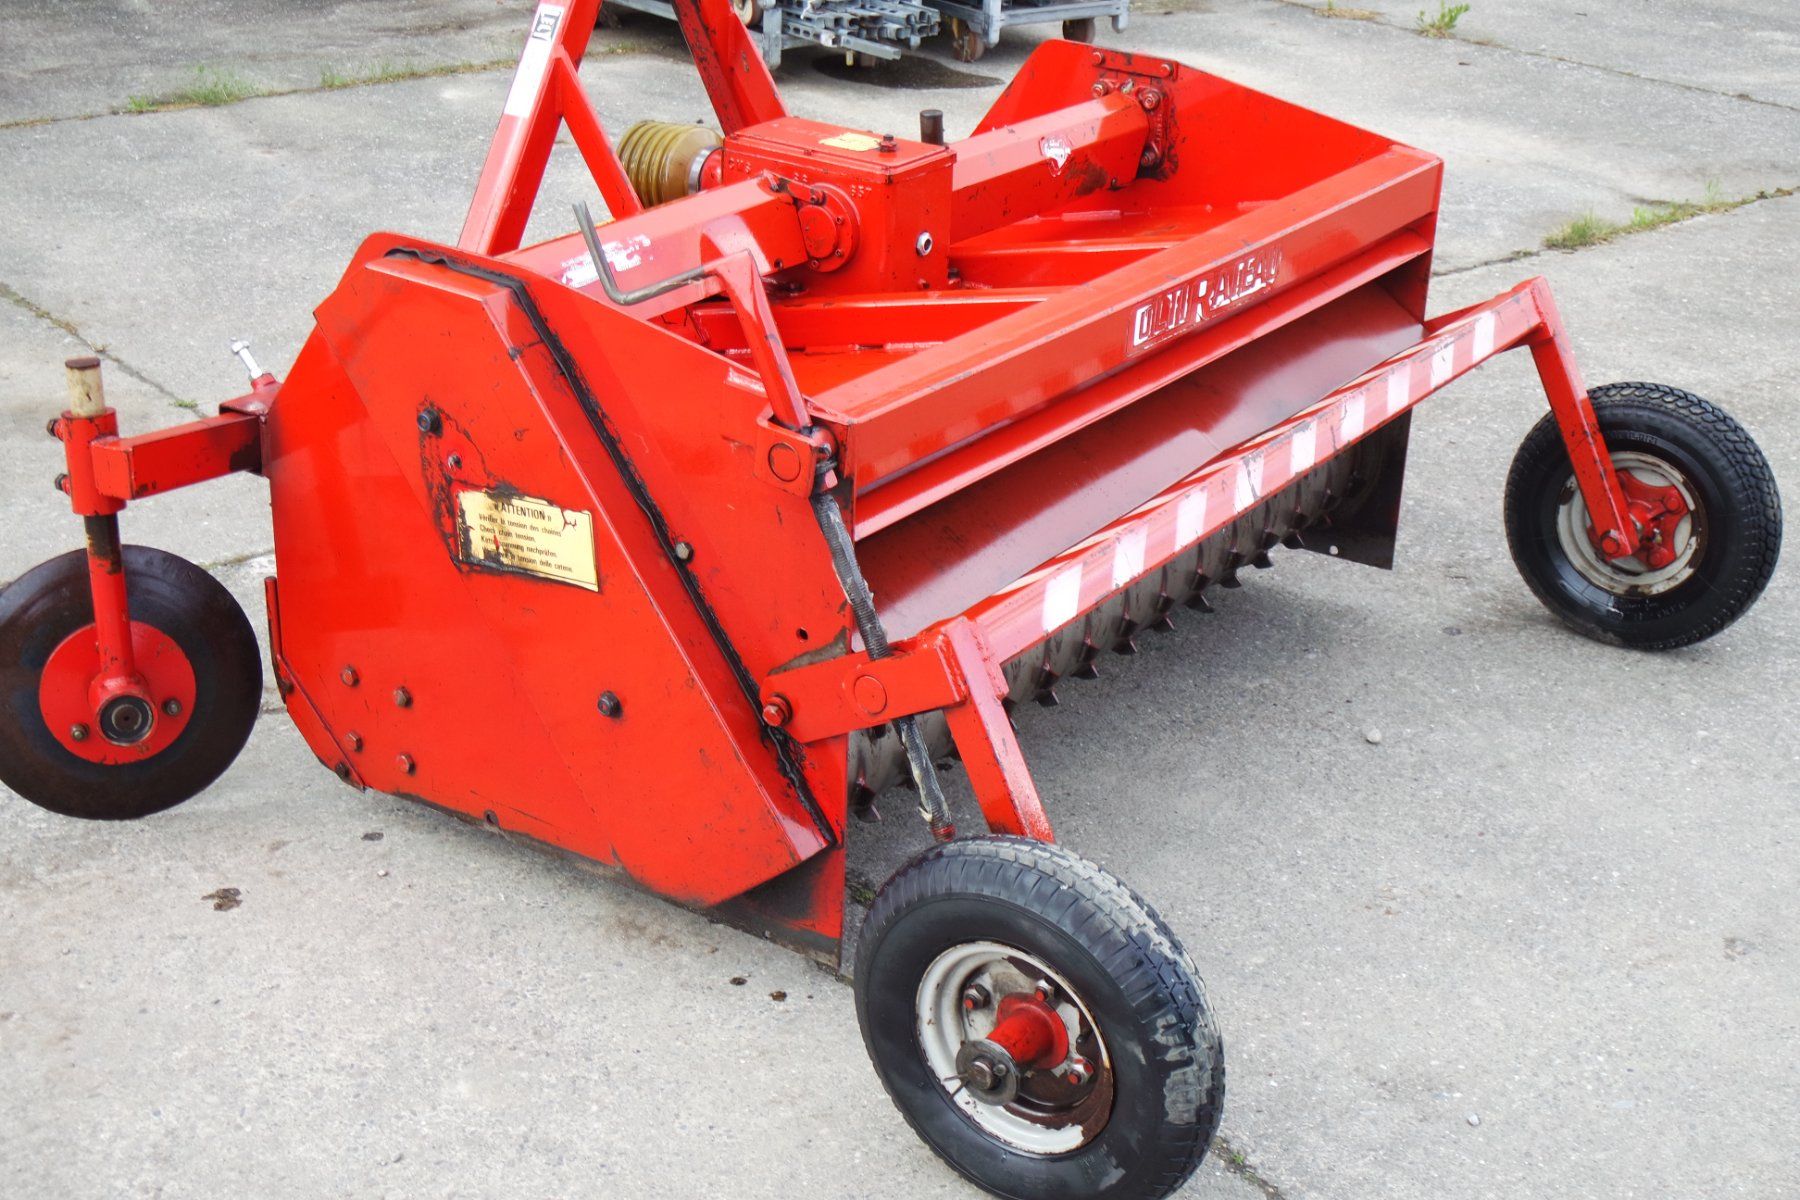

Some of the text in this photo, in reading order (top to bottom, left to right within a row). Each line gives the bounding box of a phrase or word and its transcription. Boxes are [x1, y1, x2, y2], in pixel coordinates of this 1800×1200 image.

[501, 503, 546, 521] ATTENTION
[479, 524, 495, 534] Check
[498, 529, 512, 538] chain
